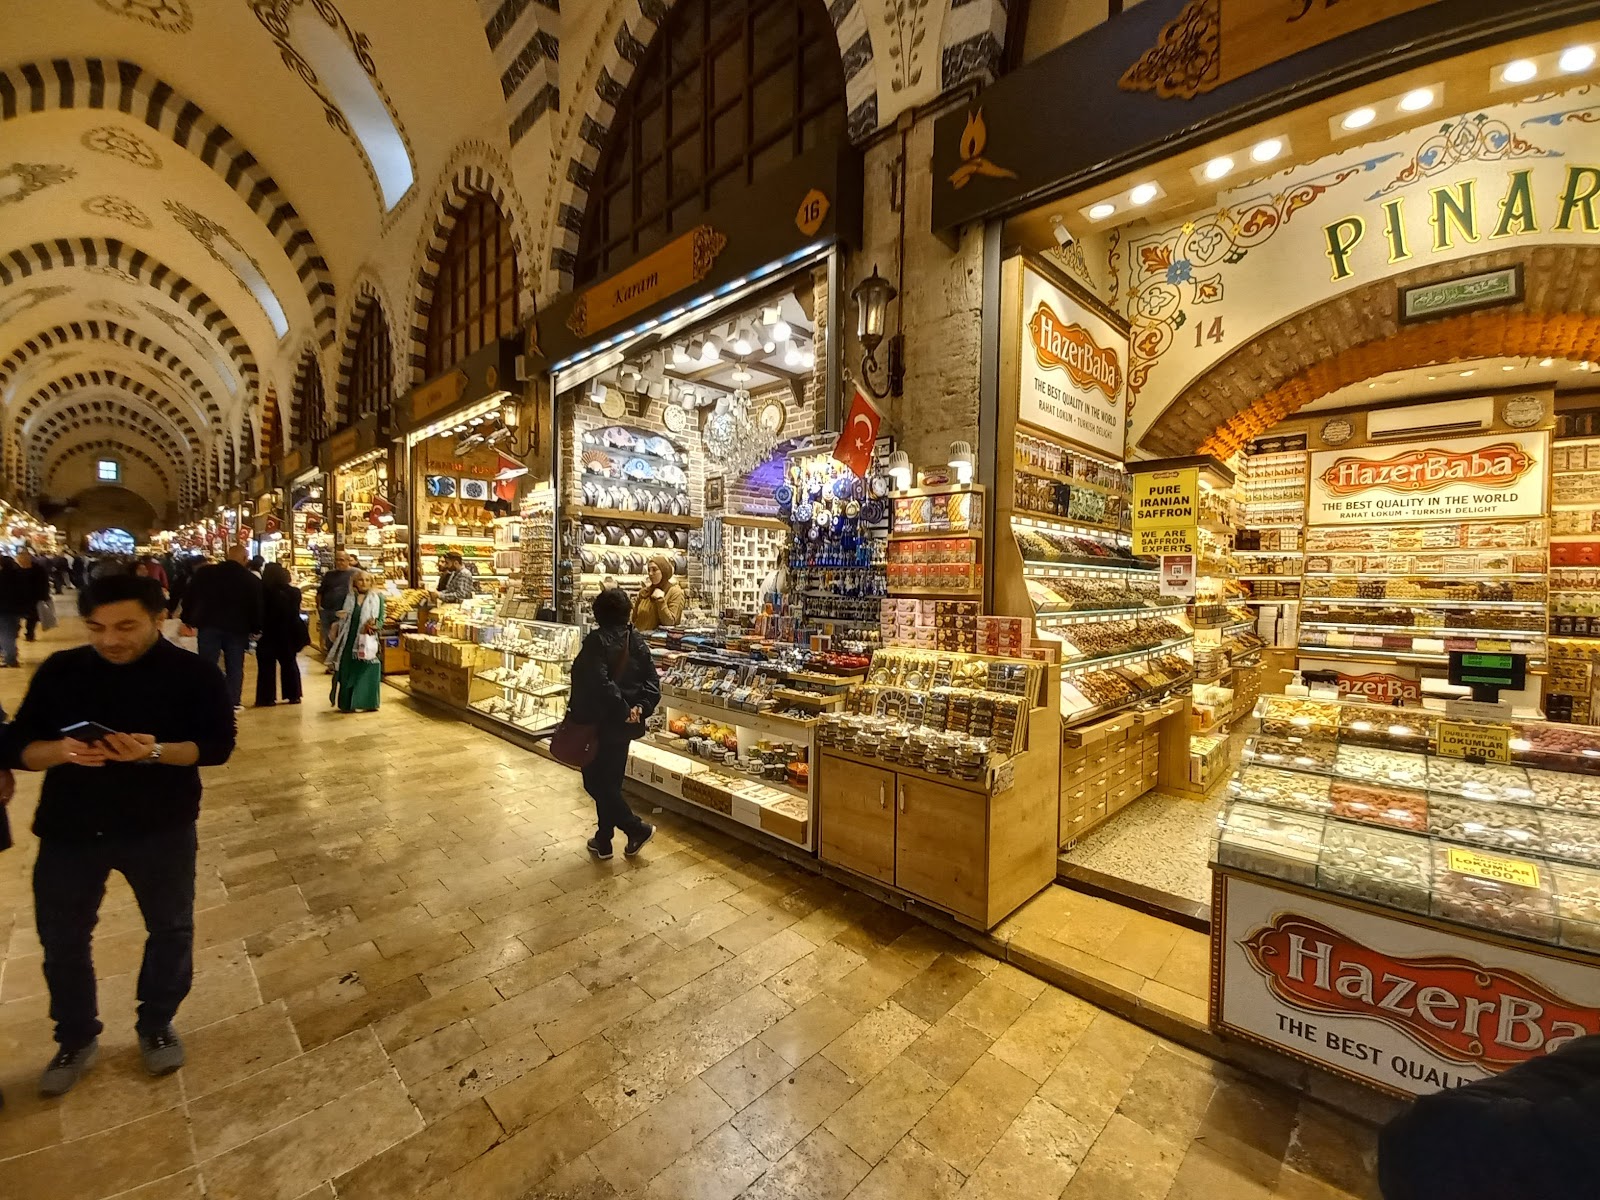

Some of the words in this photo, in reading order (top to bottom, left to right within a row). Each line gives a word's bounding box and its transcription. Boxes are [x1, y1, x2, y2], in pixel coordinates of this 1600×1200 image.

[803, 199, 820, 224] 16
[1321, 162, 1600, 284] PINAR
[612, 271, 659, 307] Karam
[1194, 315, 1225, 348] 14
[1040, 314, 1116, 389] HazerBaba
[1034, 377, 1047, 395] THE
[1047, 384, 1062, 402] BEST
[1062, 391, 1085, 412] QUALITY
[1084, 403, 1091, 415] IN
[1091, 405, 1100, 420] THE
[1101, 409, 1117, 427] WORLD
[1038, 400, 1056, 417] RAHAT
[1056, 408, 1073, 424] LOKUM
[1077, 417, 1096, 433] TURKISH
[1096, 425, 1113, 440] DELIGHT
[1337, 452, 1513, 487] HazerBaba
[1149, 484, 1181, 496] PURE
[1140, 496, 1190, 508] IRANIAN
[1322, 502, 1342, 512] THE
[1346, 500, 1372, 510] BEST
[1376, 498, 1425, 510] QUALITY
[1428, 497, 1441, 506] IN
[1444, 495, 1469, 505] THE
[1473, 492, 1519, 504] WORLD
[1137, 507, 1192, 519] SAFFRON
[1339, 511, 1368, 519] RAHAT
[1371, 509, 1402, 518] LOKUM
[1412, 508, 1452, 516] TURKISH
[1456, 505, 1498, 515] DELIGHT
[1141, 530, 1157, 538] WE
[1163, 529, 1187, 537] ARE
[1141, 537, 1186, 545] SAFFRON
[1142, 544, 1192, 553] EXPERTS
[1339, 679, 1418, 700] azerBa
[1443, 736, 1504, 750] LOKUMLAR
[1460, 746, 1497, 759] 1500
[1455, 857, 1530, 876] LOKUMLAR
[1480, 868, 1514, 880] 600
[1275, 1012, 1318, 1043] THE
[1325, 1030, 1383, 1066] BEST
